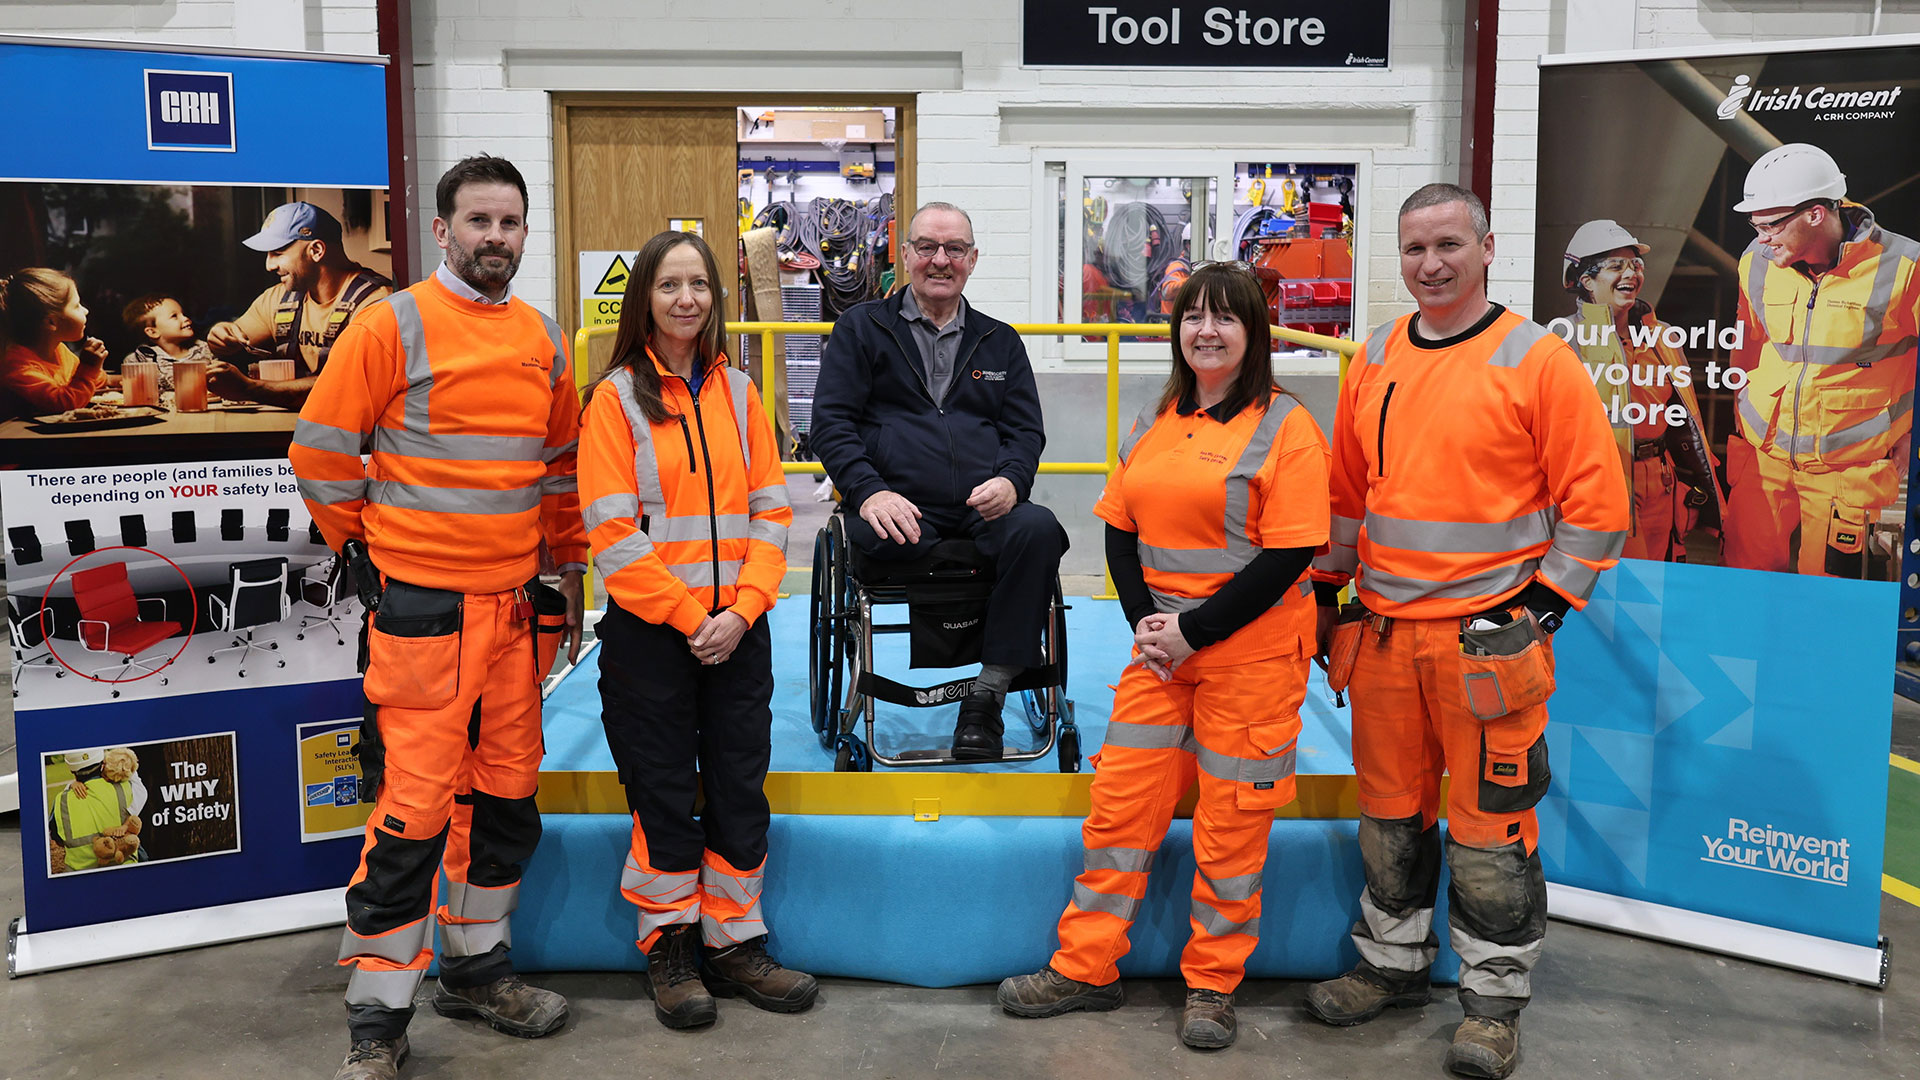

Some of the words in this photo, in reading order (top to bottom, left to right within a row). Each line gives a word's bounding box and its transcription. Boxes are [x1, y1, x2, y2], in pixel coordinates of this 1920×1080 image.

[1088, 7, 1181, 45] Tool
[1202, 6, 1326, 46] Store
[160, 90, 220, 125] CRH
[1747, 86, 1802, 112] Irish
[1804, 86, 1901, 110] Cement
[1814, 113, 1822, 121] A
[1823, 112, 1844, 121] CRH
[1845, 111, 1895, 120] COMPANY
[598, 301, 622, 314] CC
[594, 317, 602, 325] in
[1547, 316, 1616, 347] Our
[1628, 319, 1745, 350] world
[1584, 362, 1692, 388] yours
[1705, 361, 1748, 390] to
[1603, 394, 1688, 427] lore
[27, 474, 76, 487] There
[81, 473, 107, 485] are
[112, 469, 168, 486] people
[172, 467, 208, 483] (and
[212, 464, 273, 479] families
[277, 463, 297, 476] be
[51, 488, 140, 506] depending
[144, 488, 165, 500] on
[169, 484, 219, 498] YOUR
[222, 483, 270, 497] safety
[274, 482, 301, 494] lea
[314, 751, 337, 760] Safety
[324, 756, 360, 765] Interactio
[170, 761, 208, 779] The
[160, 778, 219, 803] WHY
[152, 807, 170, 827] of
[174, 801, 231, 823] Safety
[1727, 817, 1850, 860] Reinvent
[1702, 834, 1764, 866] Your
[1765, 846, 1850, 883] World
